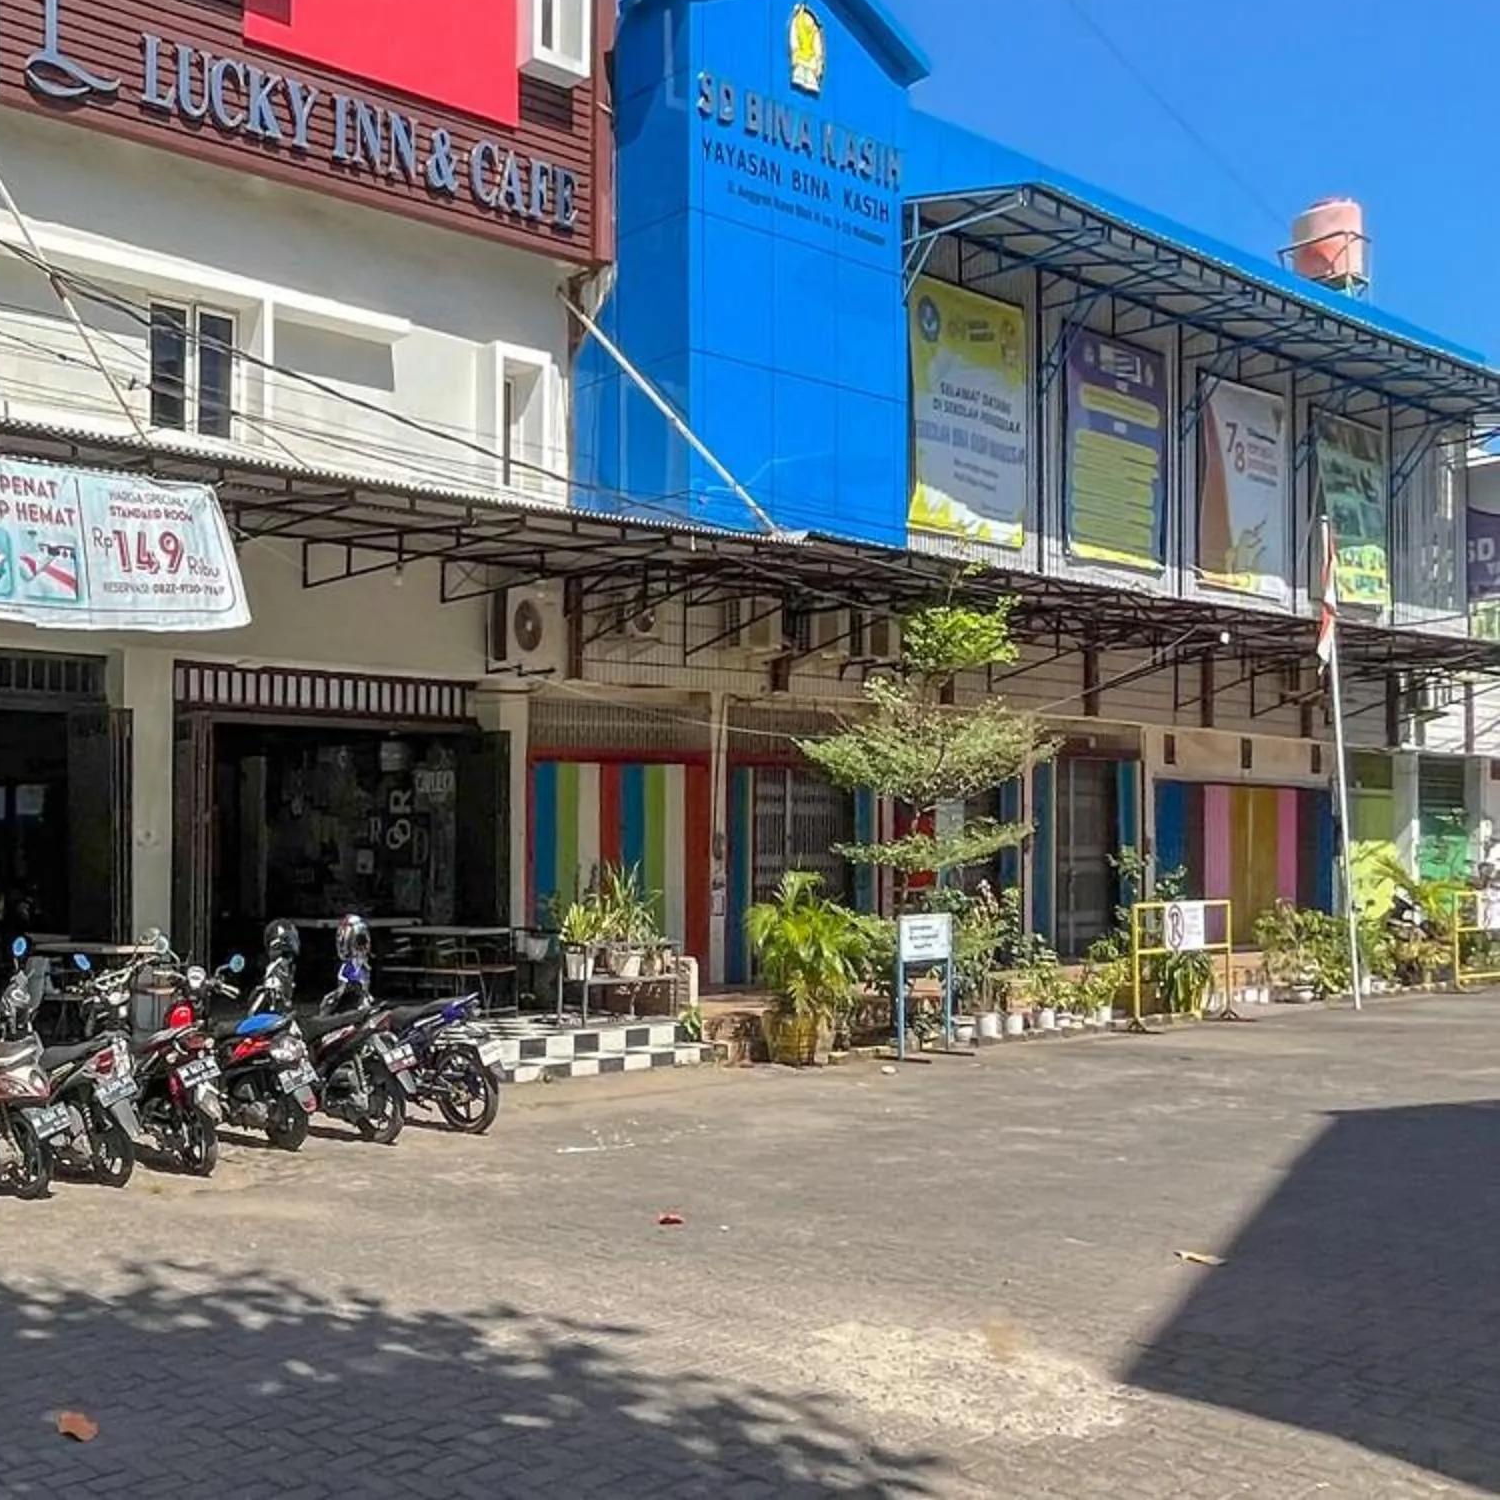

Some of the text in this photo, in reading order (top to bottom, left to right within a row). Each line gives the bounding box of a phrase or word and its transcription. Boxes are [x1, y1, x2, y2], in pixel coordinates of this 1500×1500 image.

[139, 31, 579, 229] LUCKY INN & CAFE
[697, 71, 901, 194] SD BINA KASIH
[702, 138, 781, 187] YAYASAN
[791, 169, 832, 202] BINA
[843, 187, 890, 224] KASIH
[0, 473, 58, 501] PENAT
[15, 503, 78, 528] HEMAT
[111, 529, 184, 574] 149
